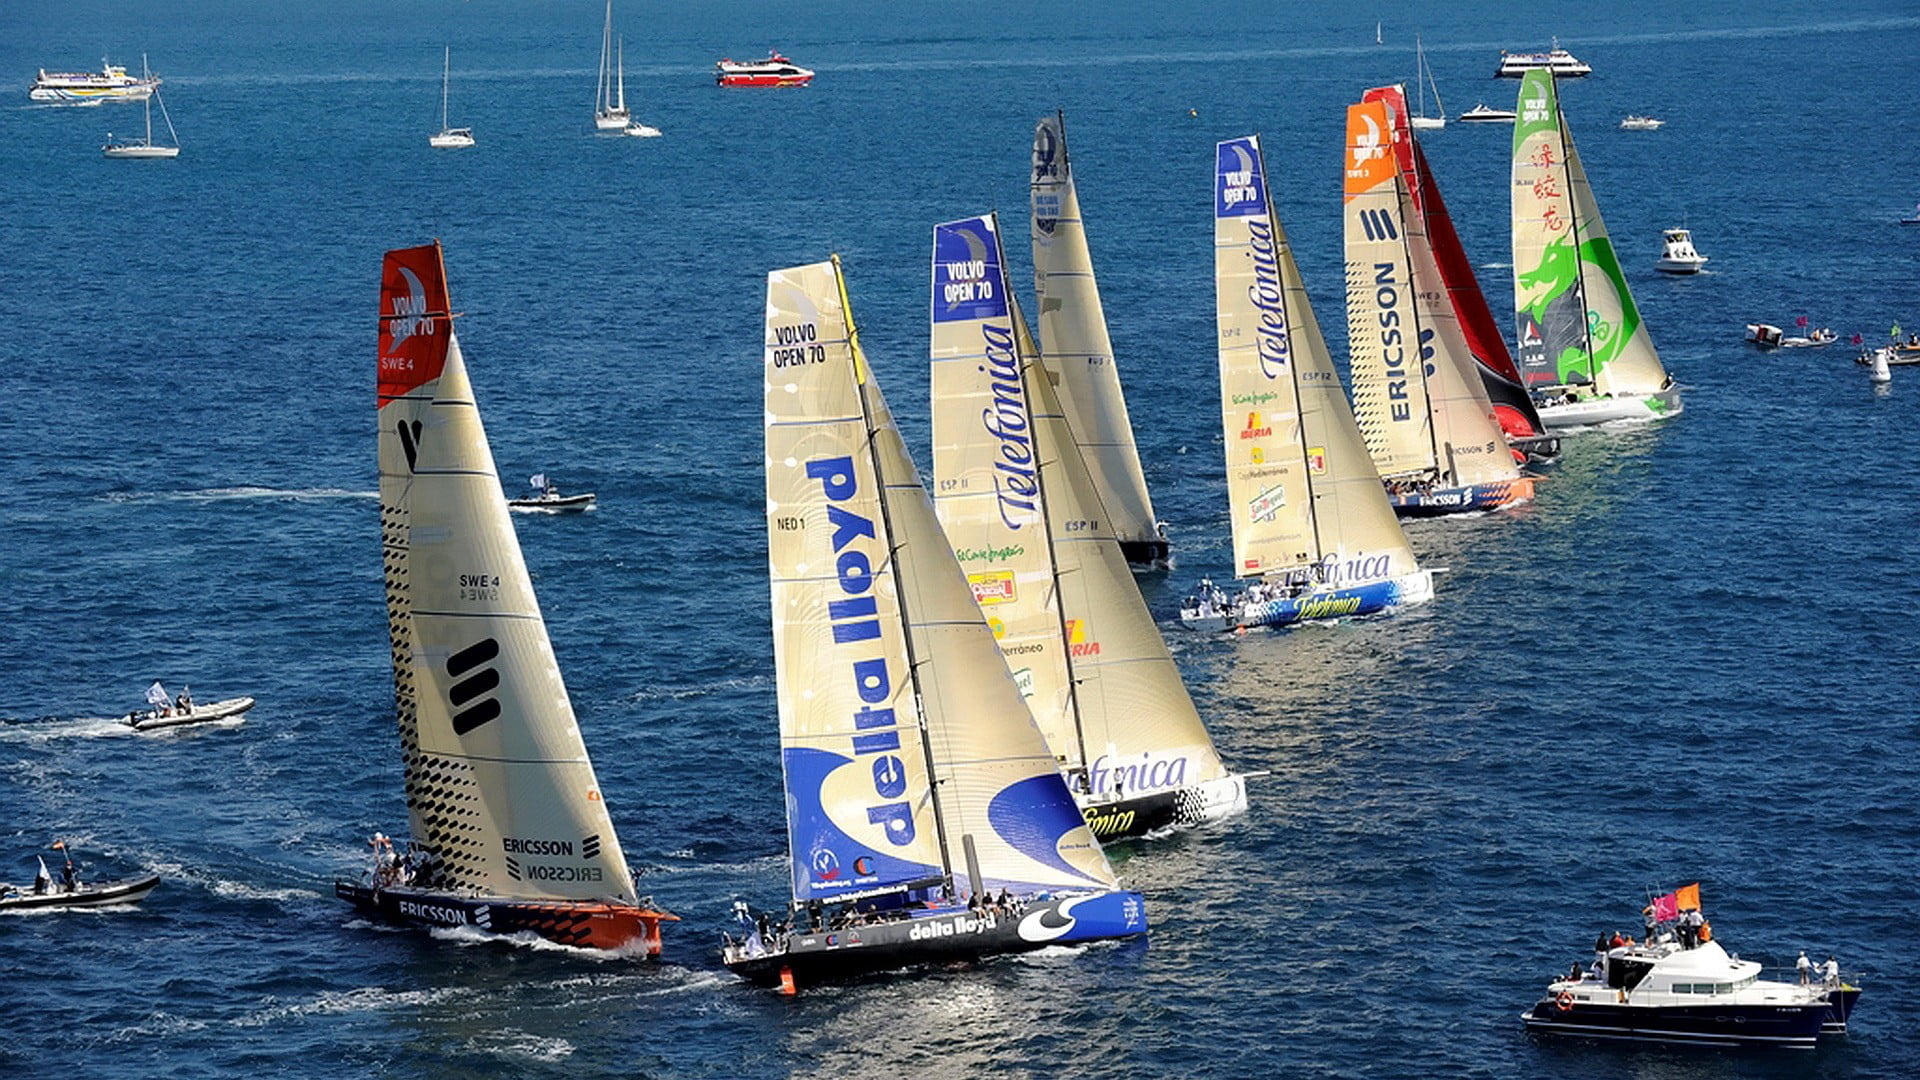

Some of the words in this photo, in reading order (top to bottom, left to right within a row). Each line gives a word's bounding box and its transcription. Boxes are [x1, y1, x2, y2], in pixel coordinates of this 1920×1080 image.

[1225, 170, 1252, 186] VOLVO
[1223, 188, 1244, 204] OPEN
[1244, 186, 1257, 202] 70
[946, 260, 986, 280] VOLVO
[944, 282, 974, 303] OPEN
[976, 281, 993, 300] 70
[392, 295, 425, 314] VOLVO
[389, 319, 417, 338] OPEN
[419, 317, 434, 336] 70
[775, 323, 817, 346] VOLVO
[1374, 261, 1411, 422] ERICSSON
[382, 357, 405, 370] SWE
[406, 359, 414, 371] 4
[773, 347, 806, 368] OPEN
[808, 345, 826, 364] 70
[777, 518, 798, 531] NED
[799, 517, 806, 530] 1
[1065, 521, 1087, 532] ESP
[806, 456, 882, 644] lloyd
[460, 574, 488, 587] SWE
[491, 575, 500, 587] 4
[1001, 643, 1043, 657] erráneo
[851, 658, 916, 846] delta
[503, 837, 573, 856] ERICSSON
[399, 900, 467, 924] ERICSSON
[909, 921, 953, 941] delta
[956, 911, 997, 935] lloyd
